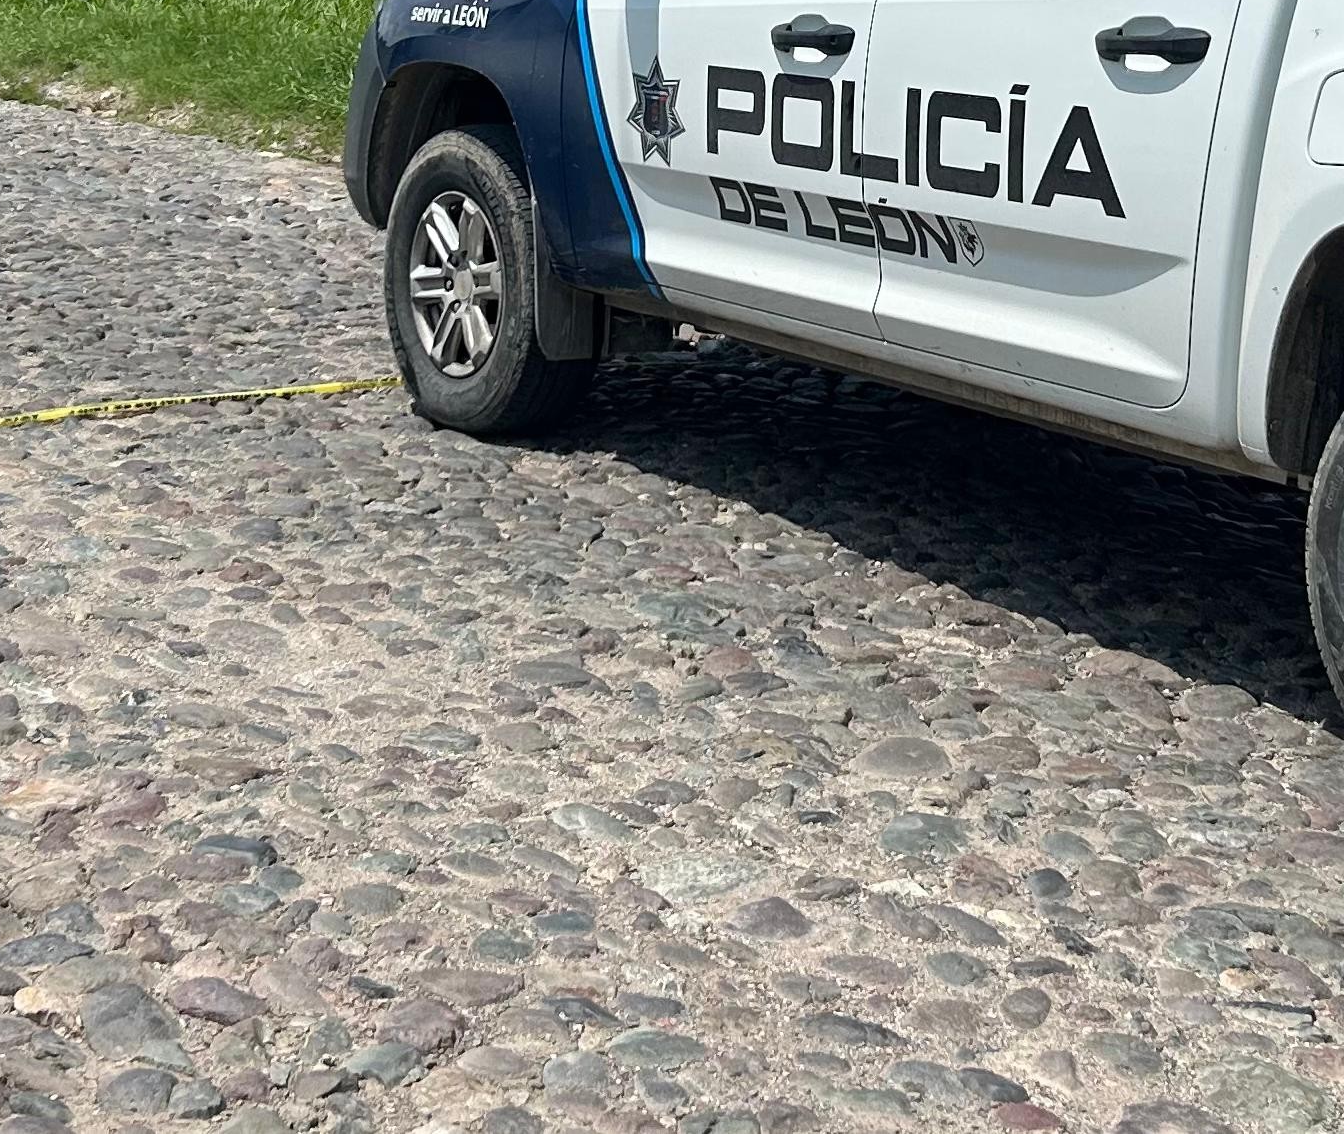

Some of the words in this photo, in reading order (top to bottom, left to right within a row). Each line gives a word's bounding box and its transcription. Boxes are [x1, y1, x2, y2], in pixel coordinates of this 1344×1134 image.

[410, 2, 444, 23] servir
[442, 8, 451, 25] a
[451, 0, 490, 29] LEÓN
[706, 65, 1128, 219] POLICÍA
[709, 176, 790, 233] DE
[793, 189, 959, 265] LEÓN
